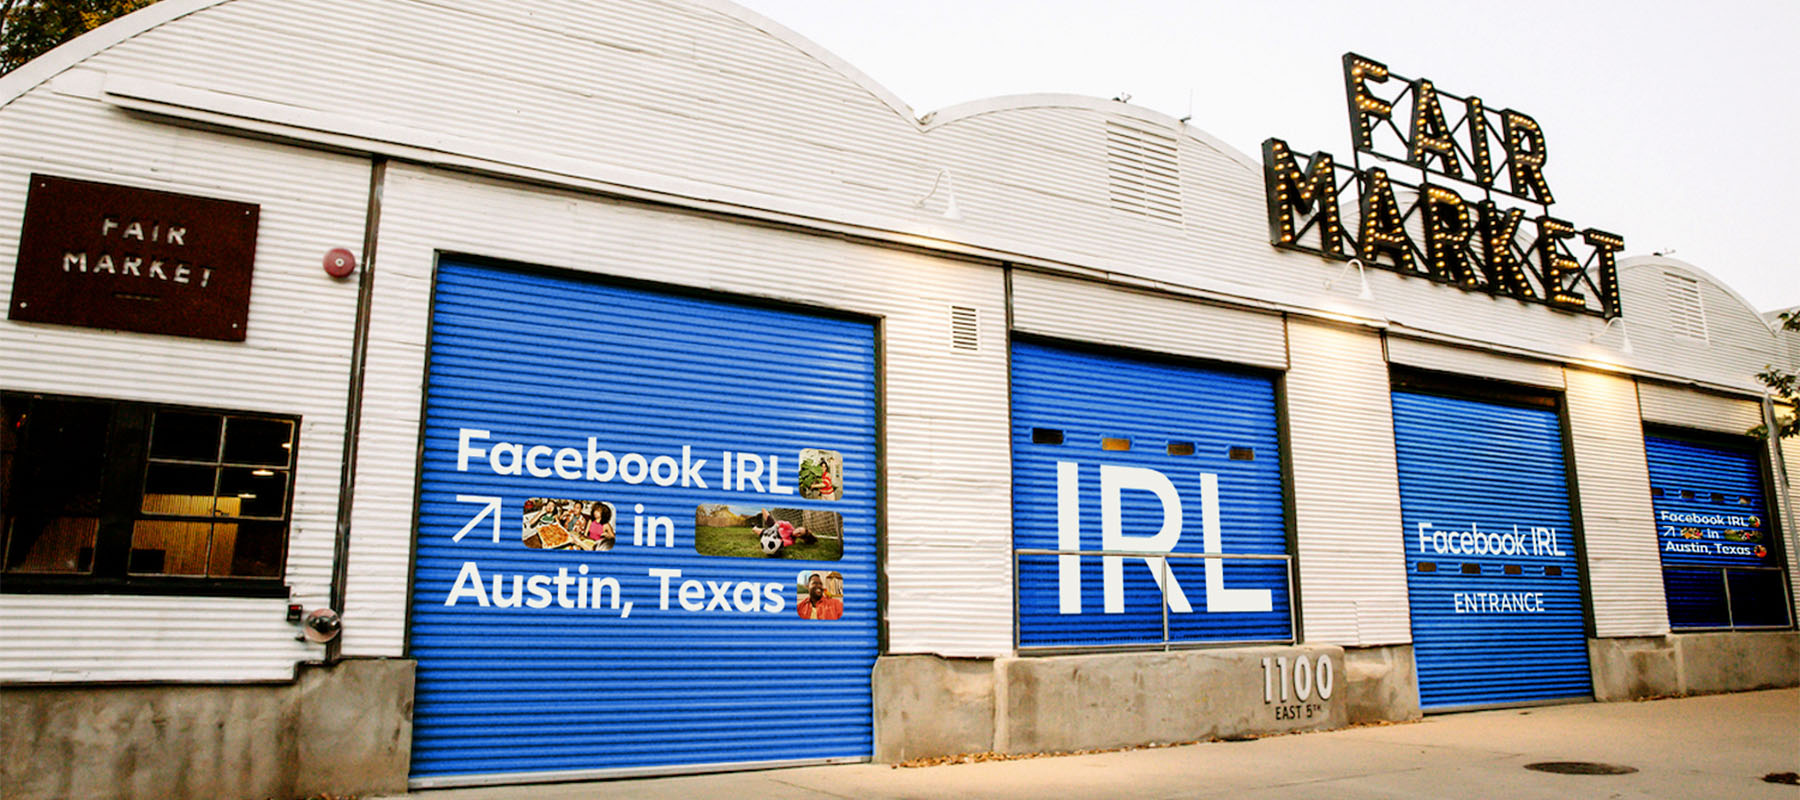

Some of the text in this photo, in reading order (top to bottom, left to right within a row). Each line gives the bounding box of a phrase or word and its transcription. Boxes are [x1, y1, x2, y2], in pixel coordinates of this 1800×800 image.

[1342, 52, 1556, 206] FAIR
[102, 217, 187, 246] FAIR
[1262, 138, 1625, 319] MARKET
[62, 251, 216, 288] MARKET
[456, 427, 794, 495] Facebook IRL
[633, 503, 675, 547] in
[1057, 460, 1273, 614] IRL
[1660, 510, 1749, 527] Facebook IRL
[1707, 528, 1720, 539] in
[1417, 522, 1566, 557] Facebook IRL
[1665, 541, 1751, 555] Austin, Texas
[444, 561, 785, 618] Austin, Texas
[1454, 592, 1545, 614] ENTRANCE
[1261, 654, 1334, 704] 1100
[1275, 705, 1302, 720] EAST
